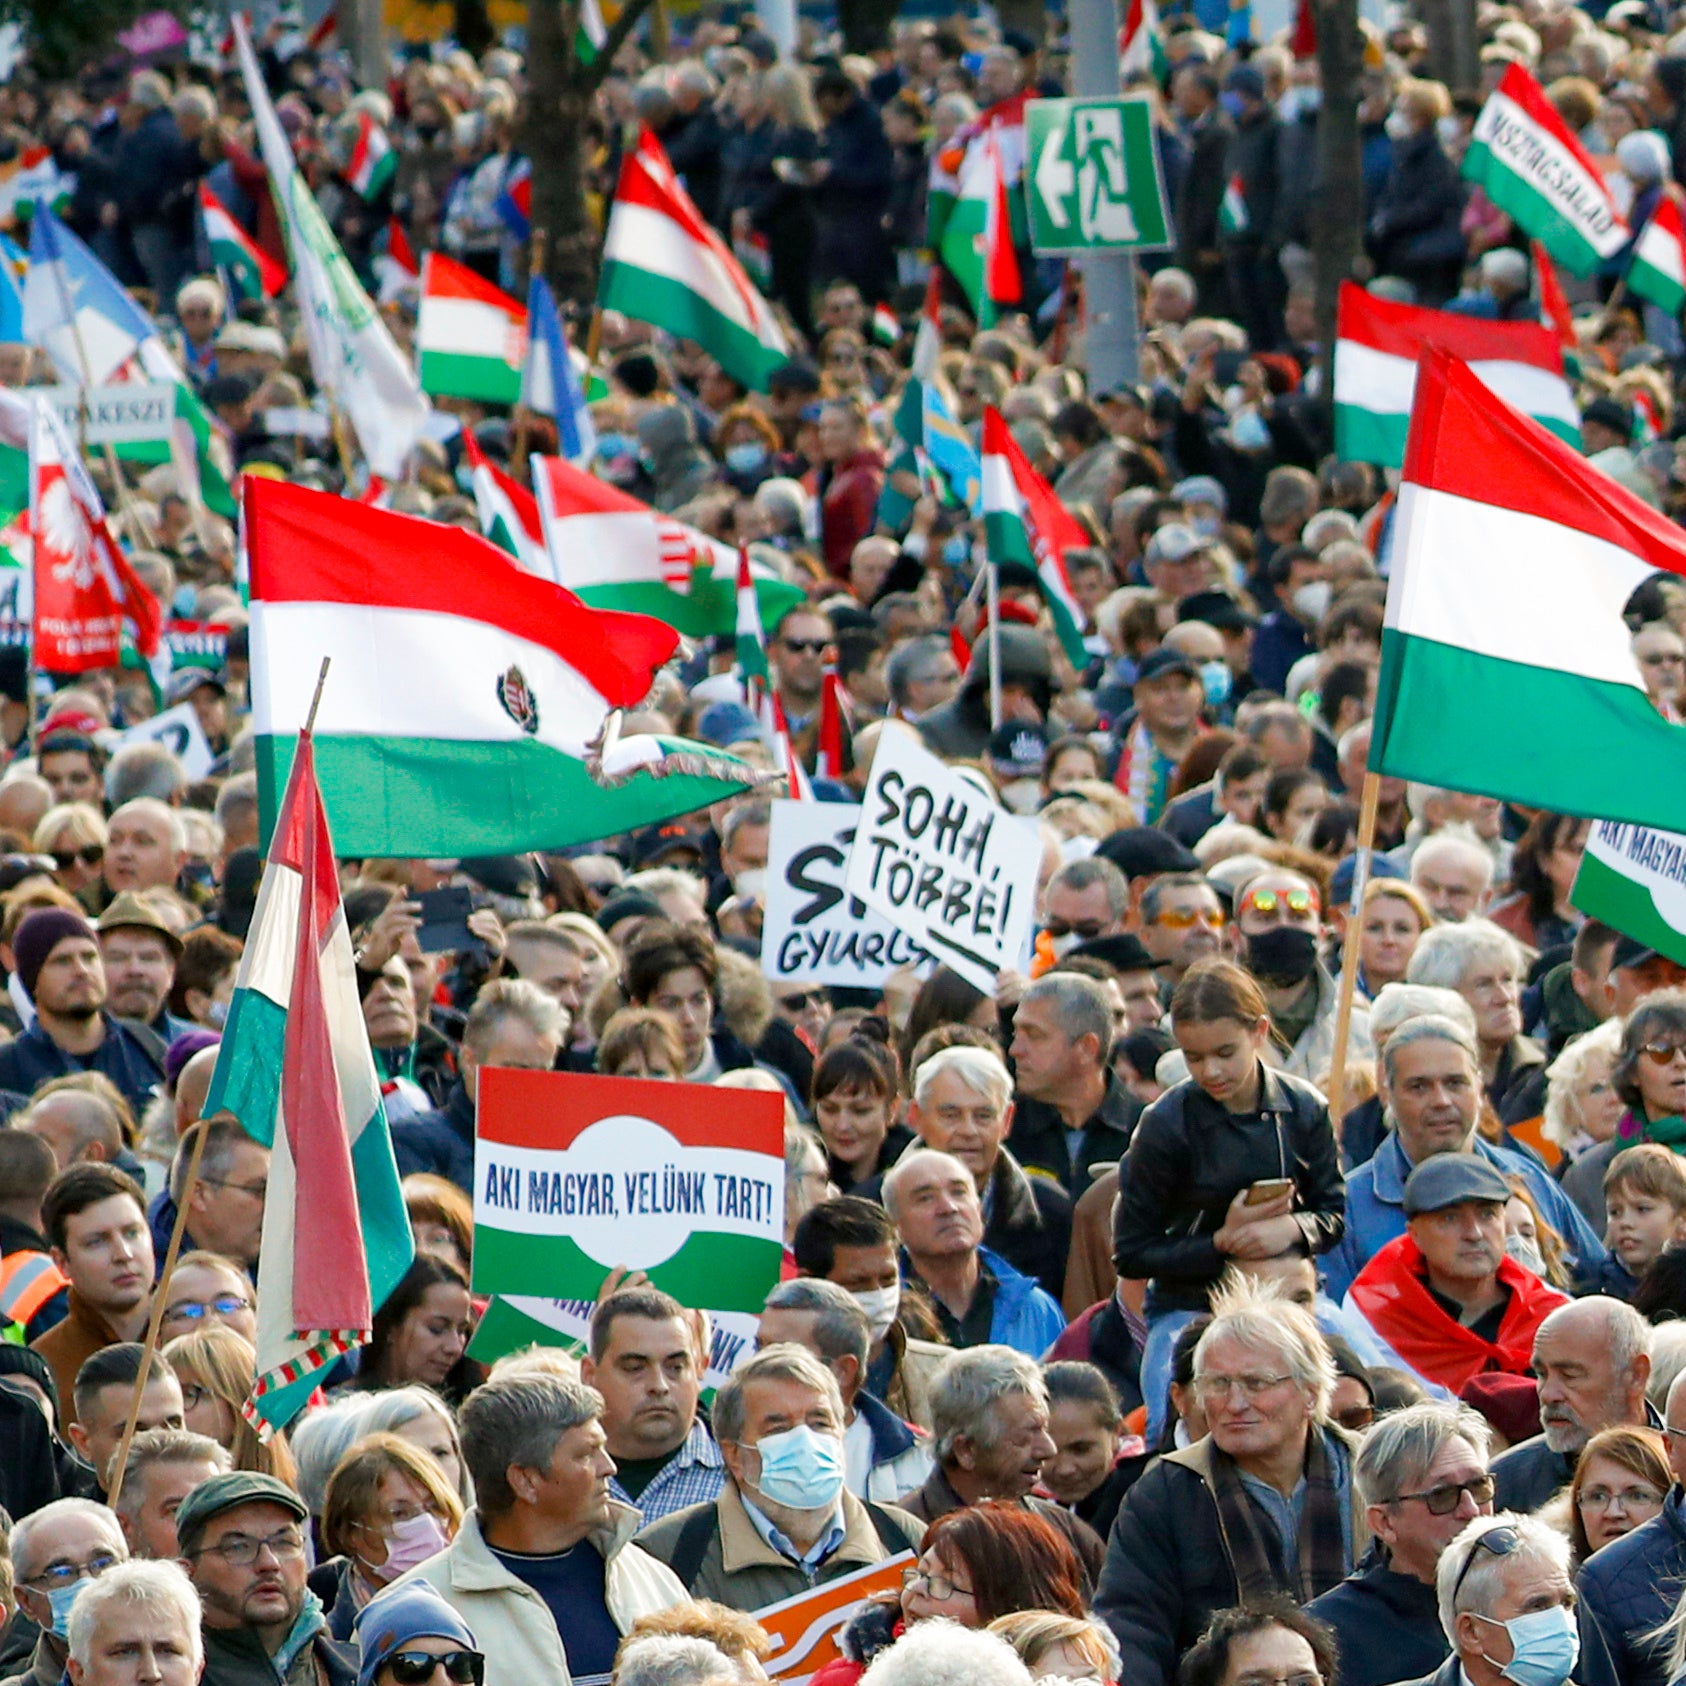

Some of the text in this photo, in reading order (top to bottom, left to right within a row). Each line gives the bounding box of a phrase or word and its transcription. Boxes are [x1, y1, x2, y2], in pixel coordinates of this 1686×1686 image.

[1598, 820, 1628, 852] AKI
[870, 836, 1014, 950] TÖBBÉ!
[485, 1163, 773, 1224] AKI MAGYAR, VELÜNK TART!
